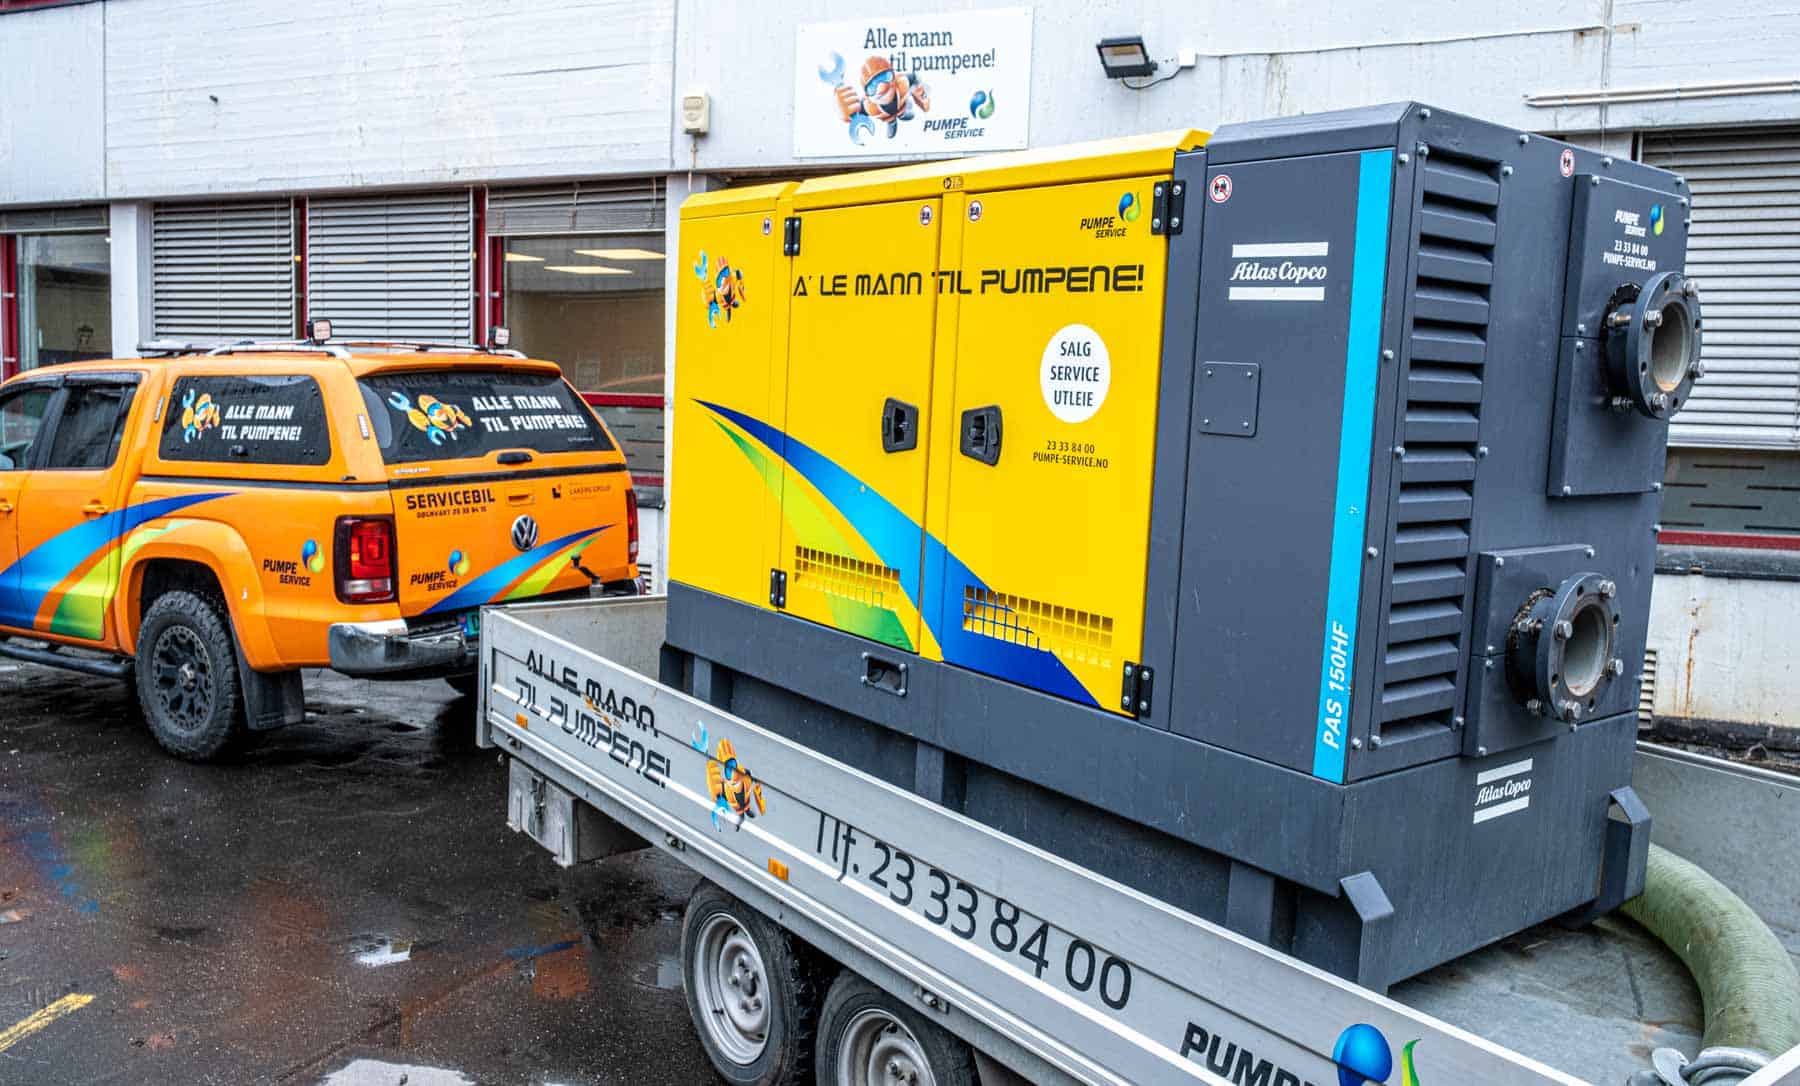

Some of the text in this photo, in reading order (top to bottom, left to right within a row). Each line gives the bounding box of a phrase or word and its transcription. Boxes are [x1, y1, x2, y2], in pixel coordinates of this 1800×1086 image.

[864, 27, 953, 49] Alle mann
[889, 48, 996, 75] til pumpene!
[923, 117, 969, 132] PUMPE
[944, 128, 985, 140] SERVICE
[1080, 216, 1115, 230] PUMPE
[1614, 209, 1640, 226] PUMPE
[1095, 227, 1127, 238] SERVICE
[855, 272, 922, 295] MANN
[931, 270, 972, 294] TIL
[981, 264, 1144, 294] PUMPENE!
[1230, 261, 1328, 284] Atlas Copco
[1060, 341, 1091, 357] SALG
[1050, 365, 1100, 382] SERVICE
[472, 395, 561, 411] ALLE MANN
[1054, 390, 1093, 406] UTLEIE
[225, 405, 295, 420] ALLE MANN
[480, 414, 588, 432] TIL PUMPENE!
[221, 425, 302, 441] TIL PUMPENE!
[1047, 440, 1095, 454] 23 33 84 00
[1032, 451, 1108, 469] PUMPE-SERVICE.NO
[406, 488, 496, 510] SERVICEBIL
[263, 559, 297, 574] PUMPE
[279, 574, 311, 587] SERVICE
[410, 570, 446, 585] PUMPE
[427, 580, 459, 592] SERVICE
[525, 649, 659, 737] ALLE MANN
[1324, 620, 1350, 750] PAS 150HF
[515, 676, 672, 789] TIL PUMPENE!
[1474, 778, 1532, 807] Atlas Copco
[869, 841, 915, 907] 23
[924, 869, 979, 940] 33
[990, 897, 1050, 979] 84
[1065, 938, 1132, 1011] 00
[1180, 1021, 1317, 1086] PUM
